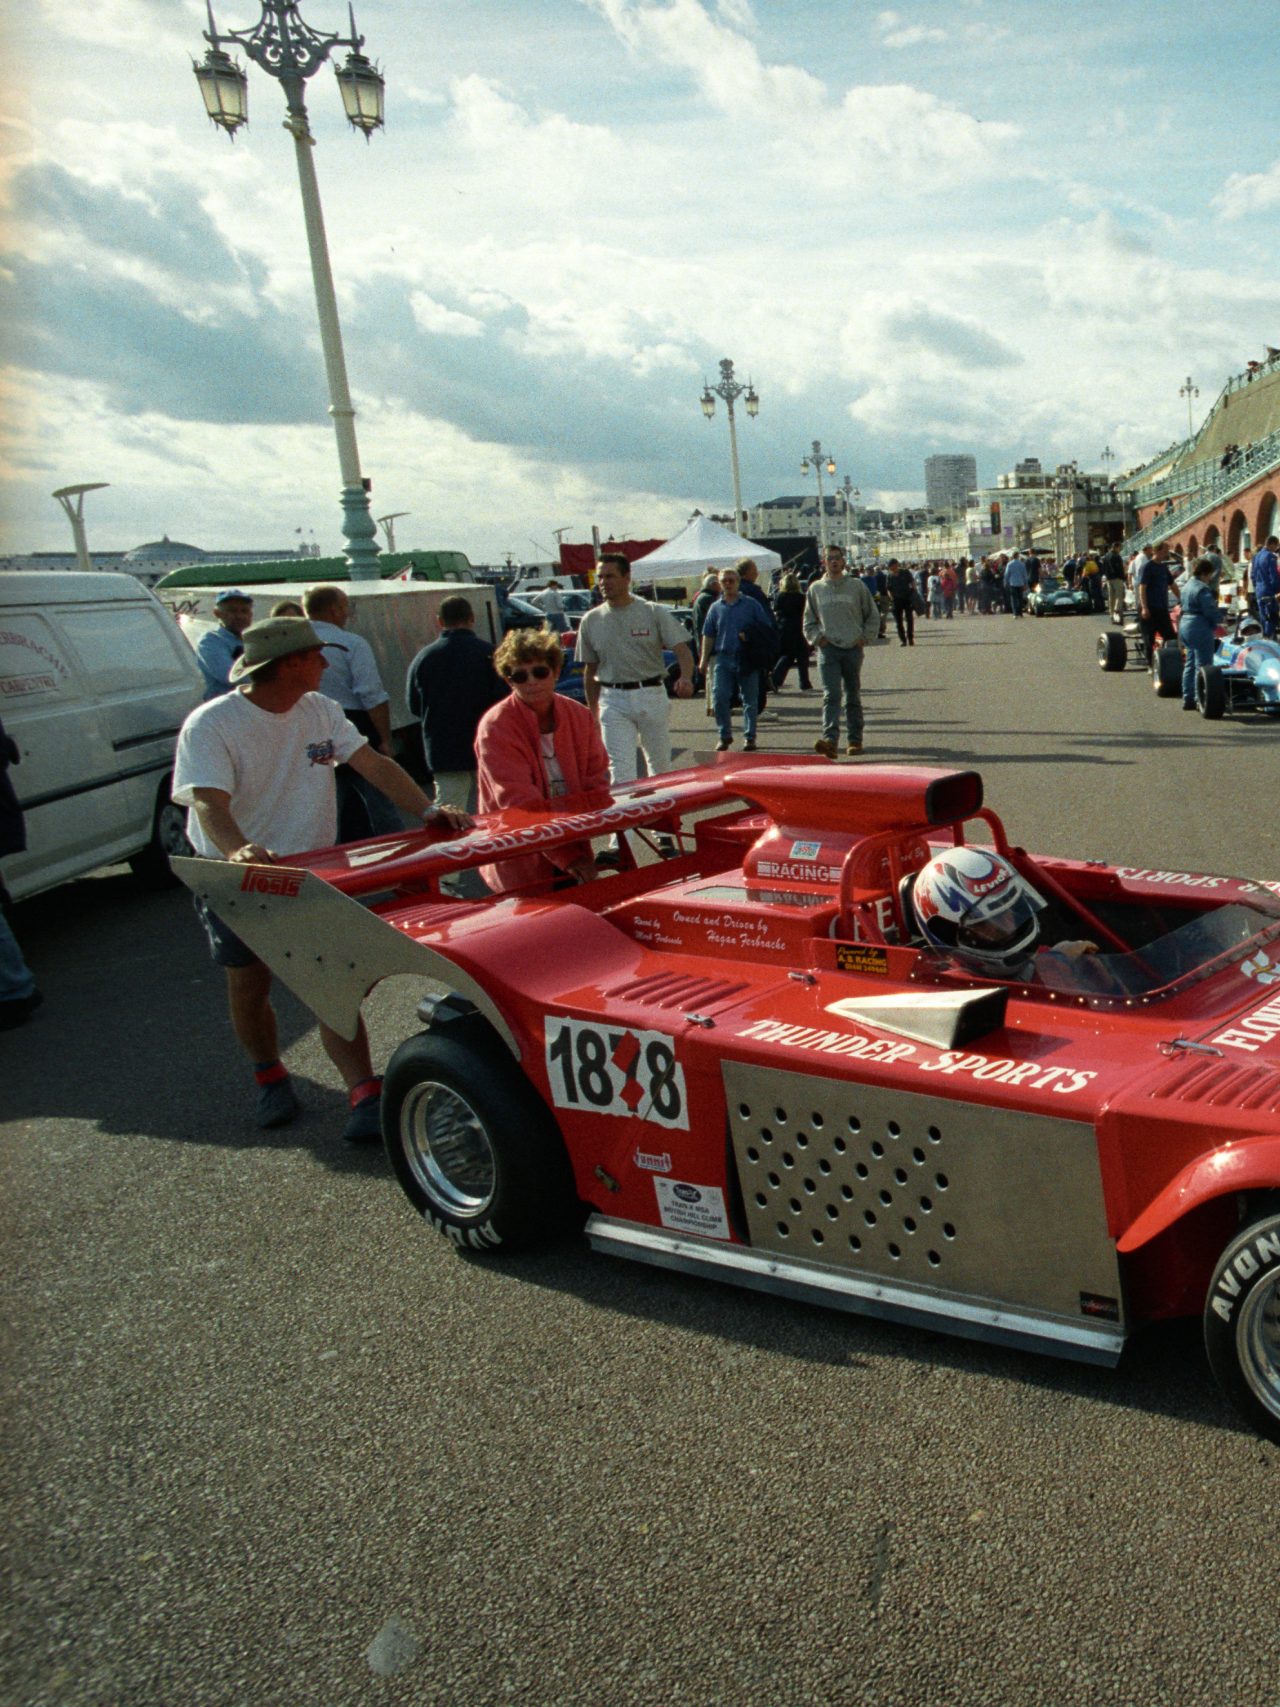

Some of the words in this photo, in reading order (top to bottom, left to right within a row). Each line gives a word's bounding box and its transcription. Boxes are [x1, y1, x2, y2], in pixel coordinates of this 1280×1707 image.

[770, 863, 831, 882] RACING
[1115, 867, 1229, 888] SPORTS
[673, 910, 701, 925] Owned
[703, 915, 721, 927] and
[723, 914, 754, 931] Driven
[757, 919, 769, 935] by
[735, 1019, 918, 1064] THUNDER
[919, 1051, 1099, 1094] SPORTS
